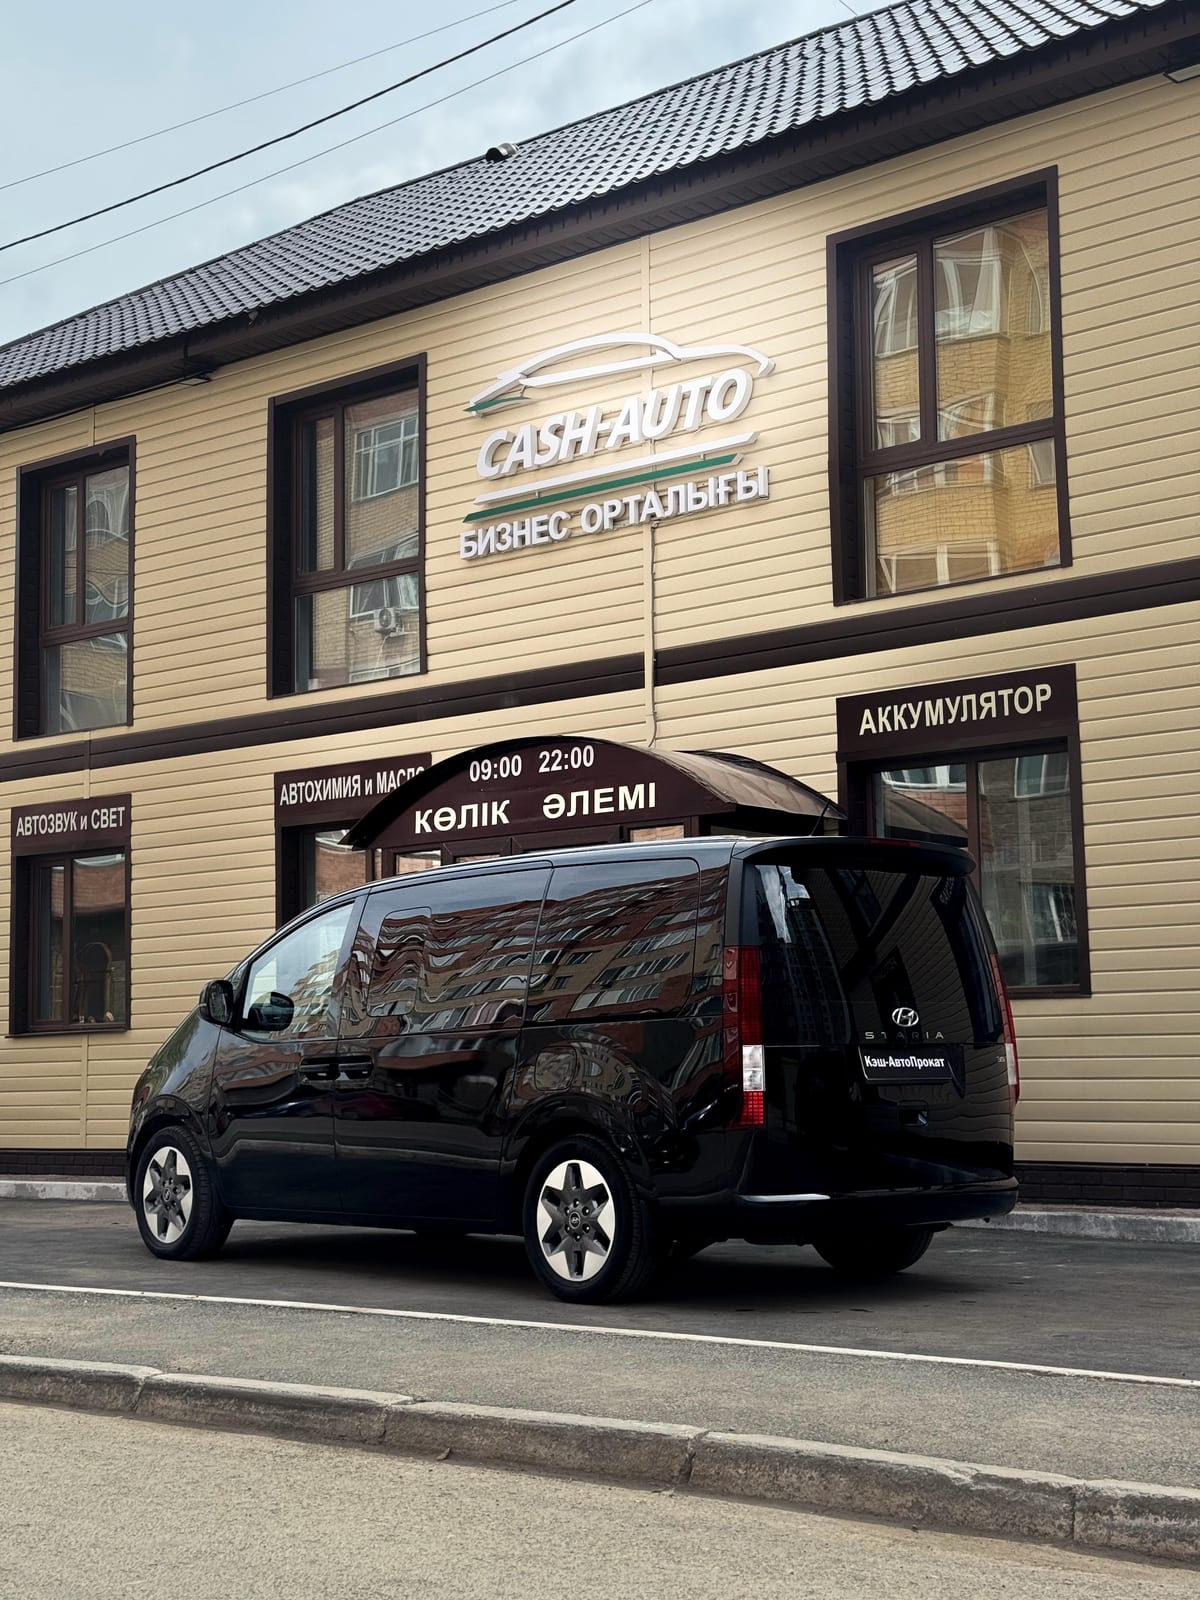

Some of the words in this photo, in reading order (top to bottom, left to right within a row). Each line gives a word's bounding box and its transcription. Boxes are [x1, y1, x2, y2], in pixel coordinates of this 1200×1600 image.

[476, 368, 753, 480] CASH-AUTO
[459, 510, 572, 560] БИЗНЕС
[580, 465, 769, 534] ОРТАЛЫҒЫ
[859, 683, 1052, 735] АККУМУЛЯТОР
[469, 754, 523, 782] 09:00
[539, 744, 595, 773] 22:00
[279, 774, 361, 806] АВТОХИМИЯ
[364, 778, 373, 796] и
[414, 799, 510, 834] КӨЛІК
[543, 782, 656, 819] ӘЛЕМІ
[16, 811, 78, 837] АВТОЗВУК
[80, 815, 88, 830] и
[91, 806, 125, 829] СВЕТ
[864, 1031, 945, 1040] STARIA
[864, 1055, 945, 1070] Кэш-АвтоПрокат
